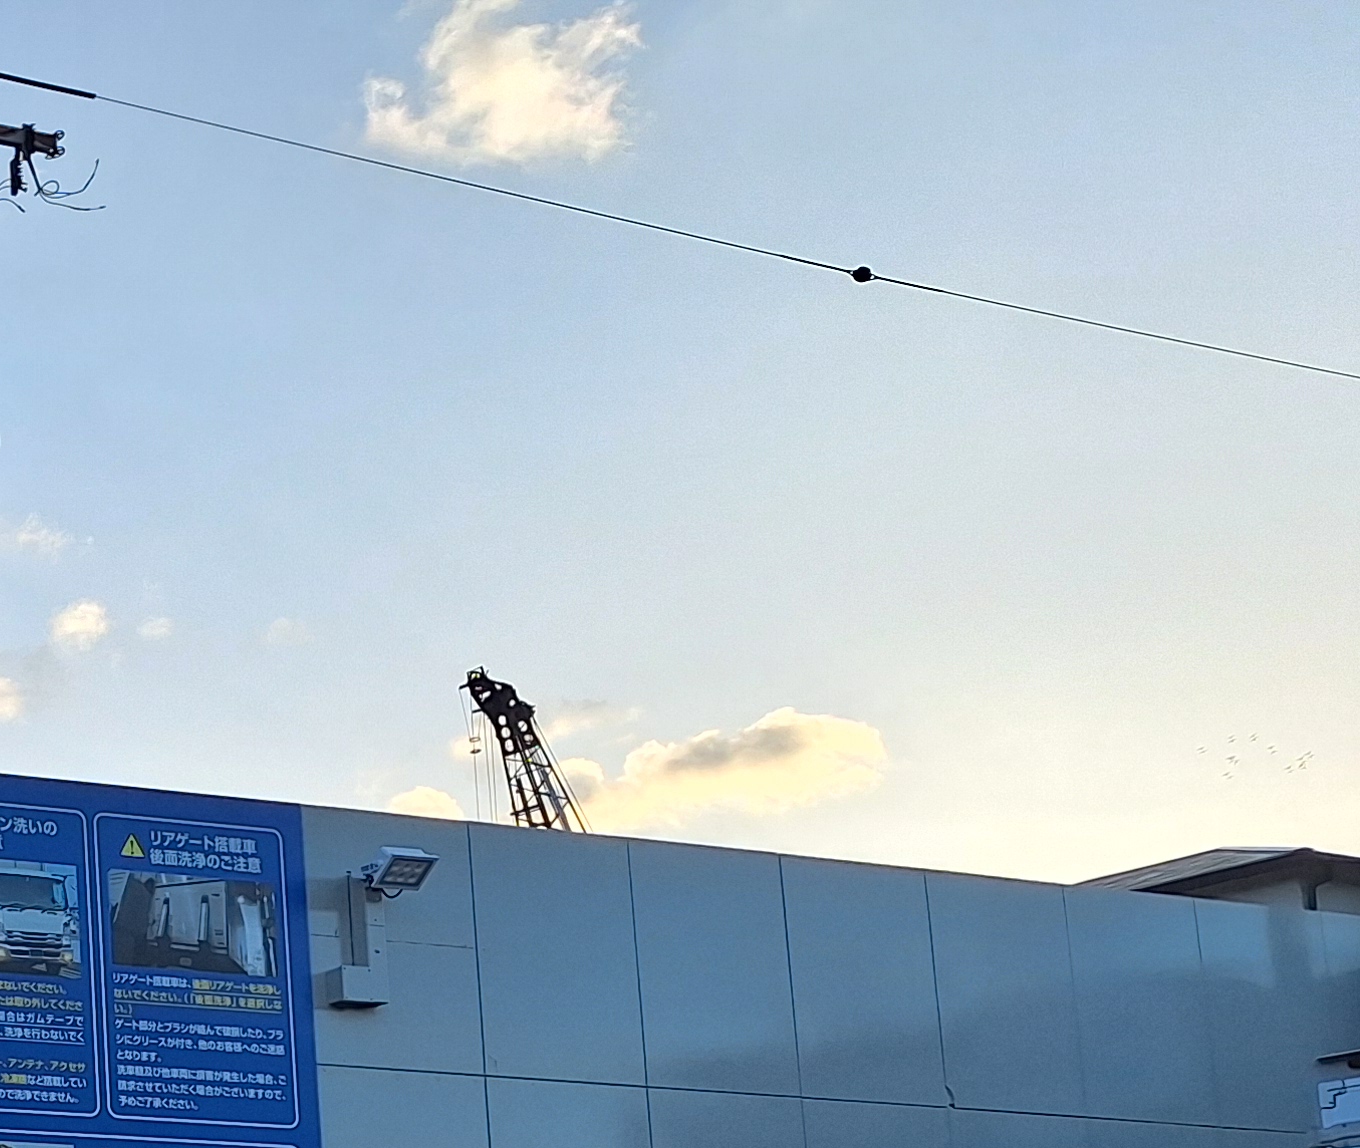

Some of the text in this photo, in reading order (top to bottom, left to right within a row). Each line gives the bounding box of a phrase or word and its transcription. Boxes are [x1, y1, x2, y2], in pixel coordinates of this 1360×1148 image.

[150, 830, 257, 855] リアゲート搭載車
[150, 848, 262, 874] 後面洗浄のご注意
[116, 1050, 162, 1063] となります。
